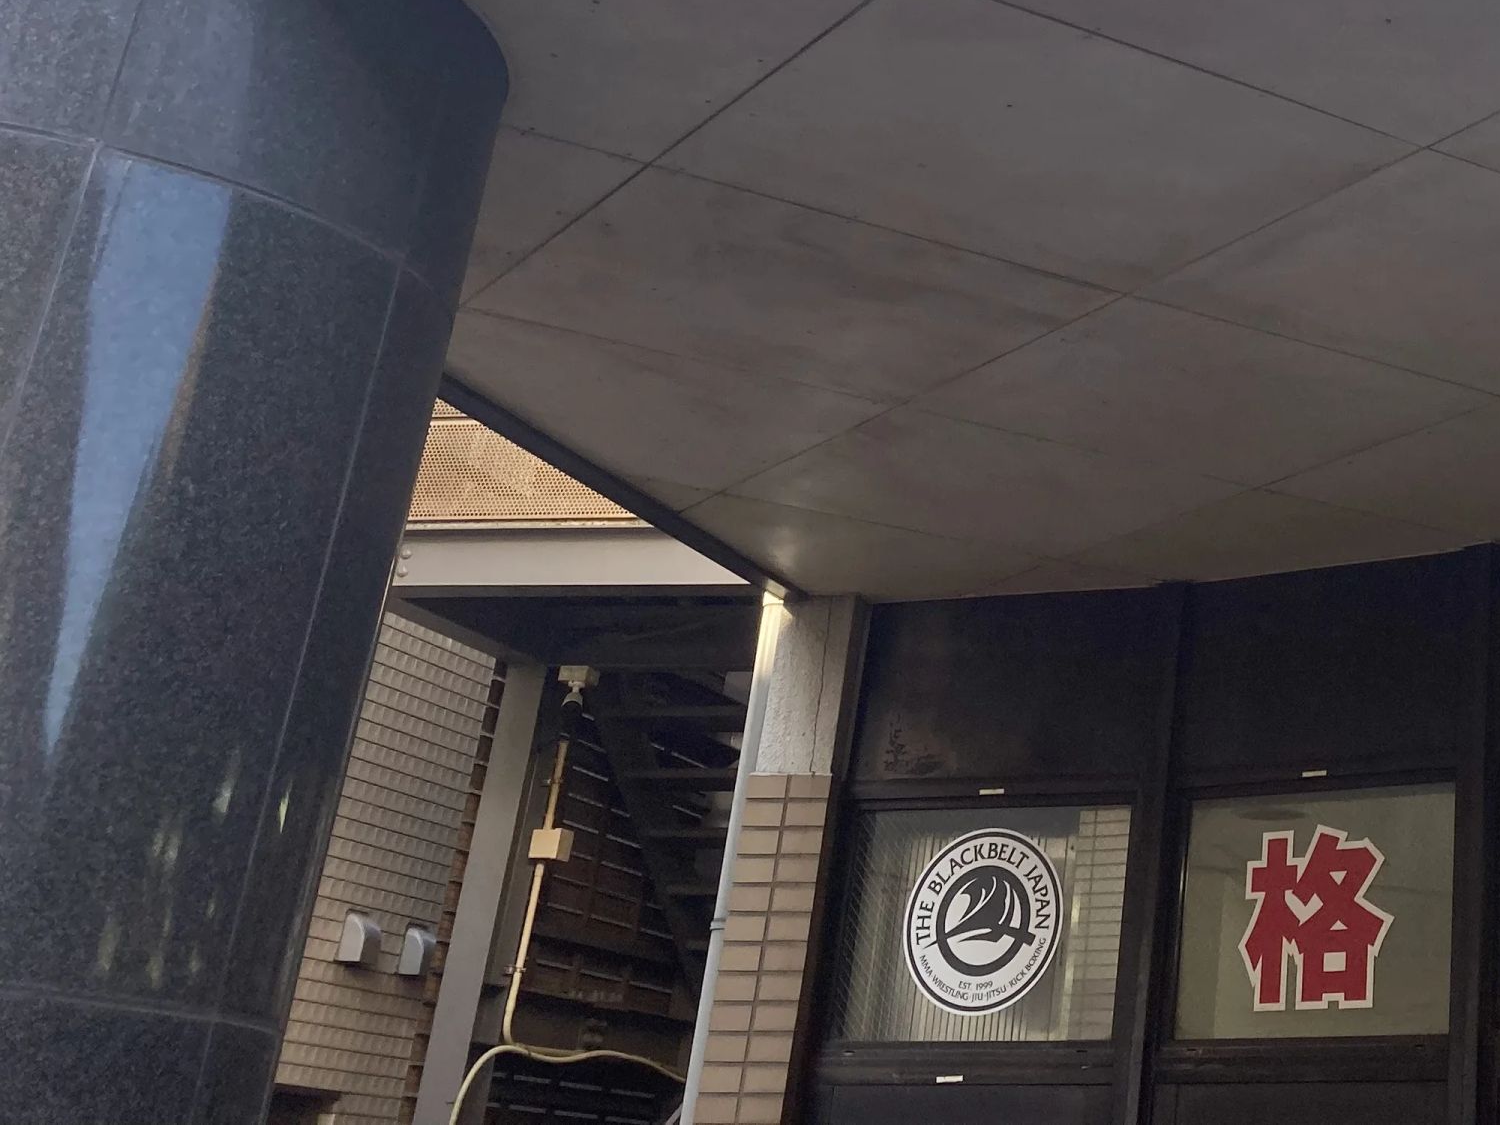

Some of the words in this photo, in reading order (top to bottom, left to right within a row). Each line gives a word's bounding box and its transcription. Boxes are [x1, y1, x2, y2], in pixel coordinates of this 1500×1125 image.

[916, 900, 935, 946] THE
[928, 842, 1030, 896] BLACKBELT
[1023, 865, 1050, 931] JAPAN
[1024, 938, 1047, 972] BOXING
[976, 980, 994, 991] 1999
